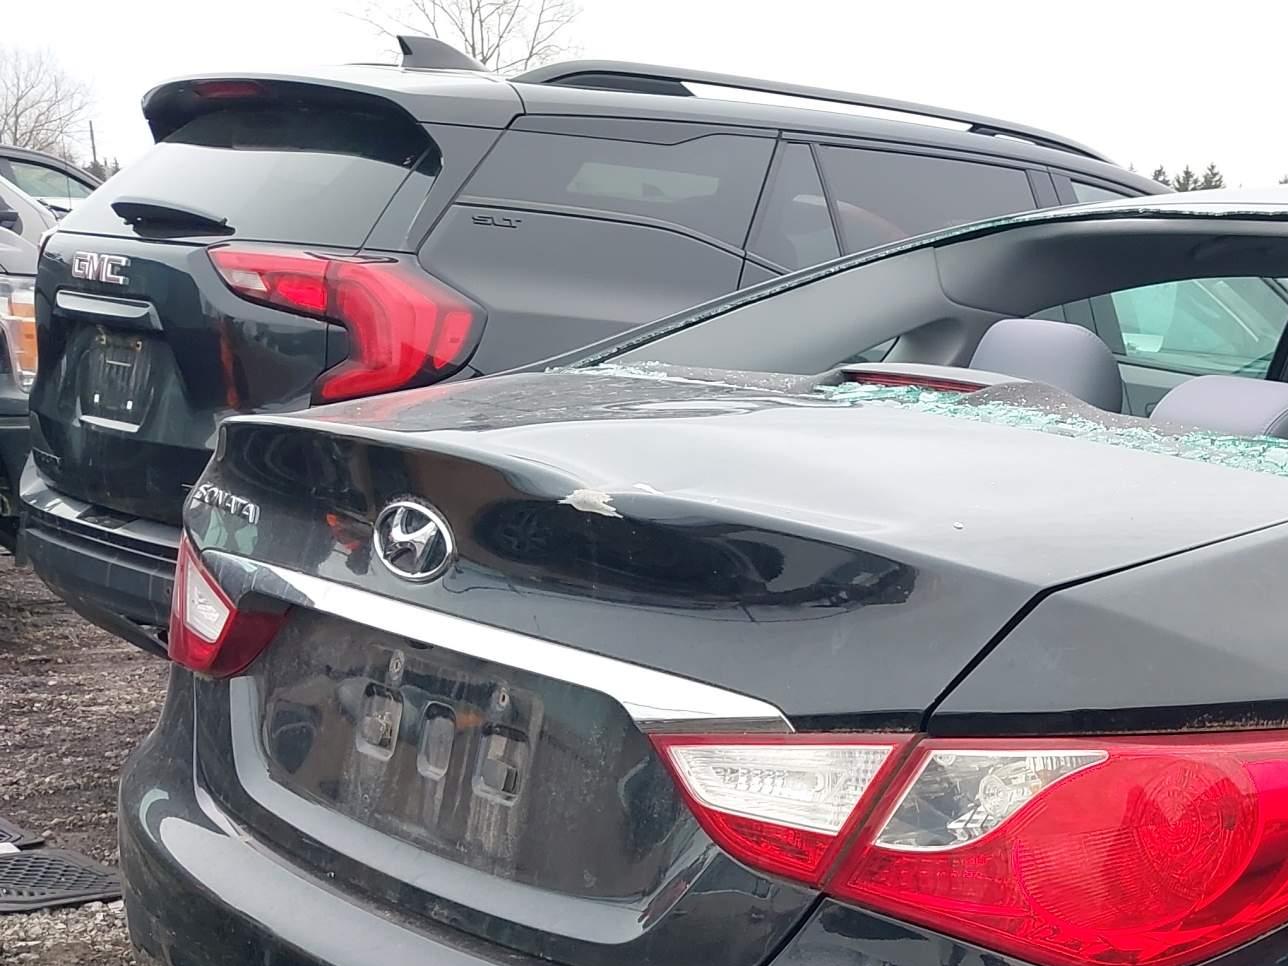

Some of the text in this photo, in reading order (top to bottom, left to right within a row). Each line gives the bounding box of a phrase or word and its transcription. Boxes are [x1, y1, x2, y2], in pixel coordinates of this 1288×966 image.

[472, 215, 522, 229] SLT
[72, 251, 131, 285] GMC
[193, 483, 260, 525] SONATA
